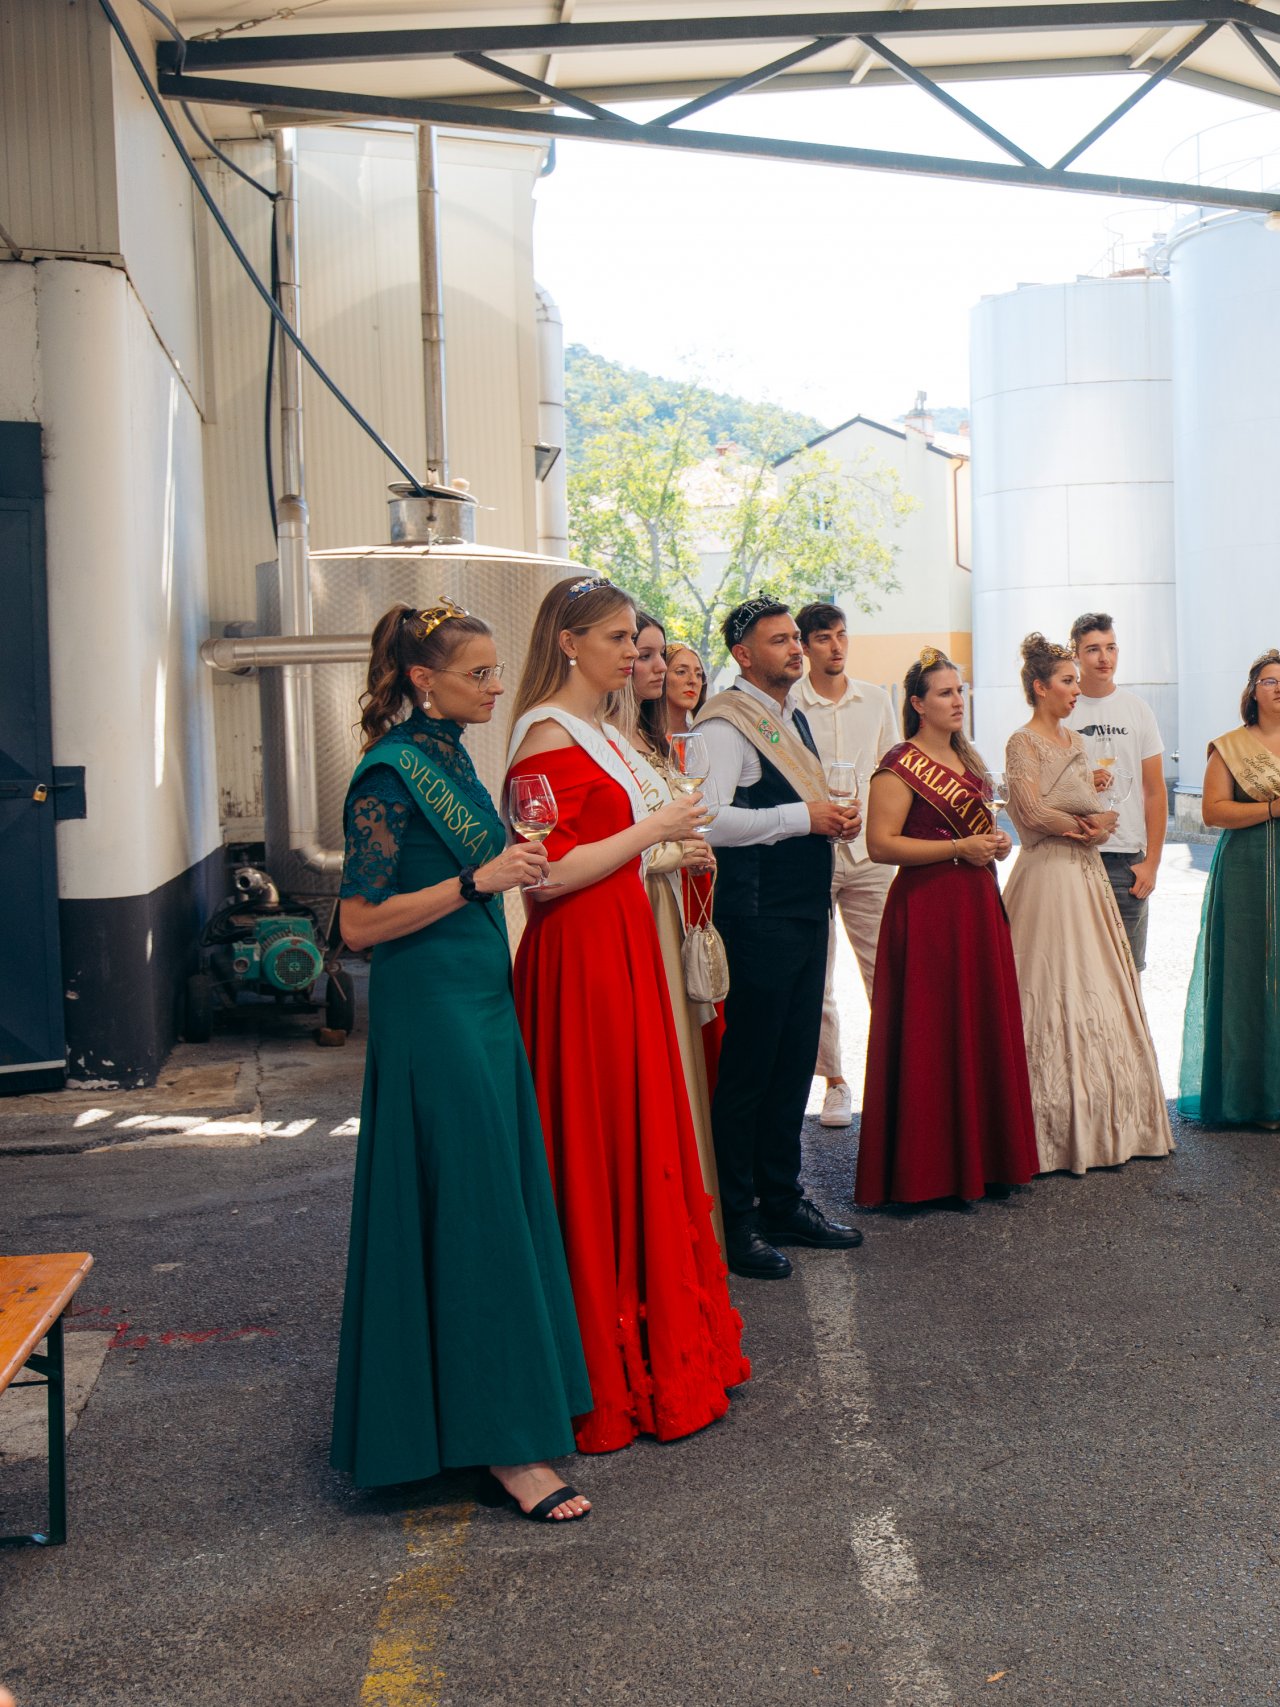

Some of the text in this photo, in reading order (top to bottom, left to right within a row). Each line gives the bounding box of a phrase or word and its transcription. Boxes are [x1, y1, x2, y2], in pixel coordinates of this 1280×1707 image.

[1095, 724, 1129, 737] Wine
[399, 749, 488, 857] SVEČINSKA
[898, 748, 976, 819] KRALJICA
